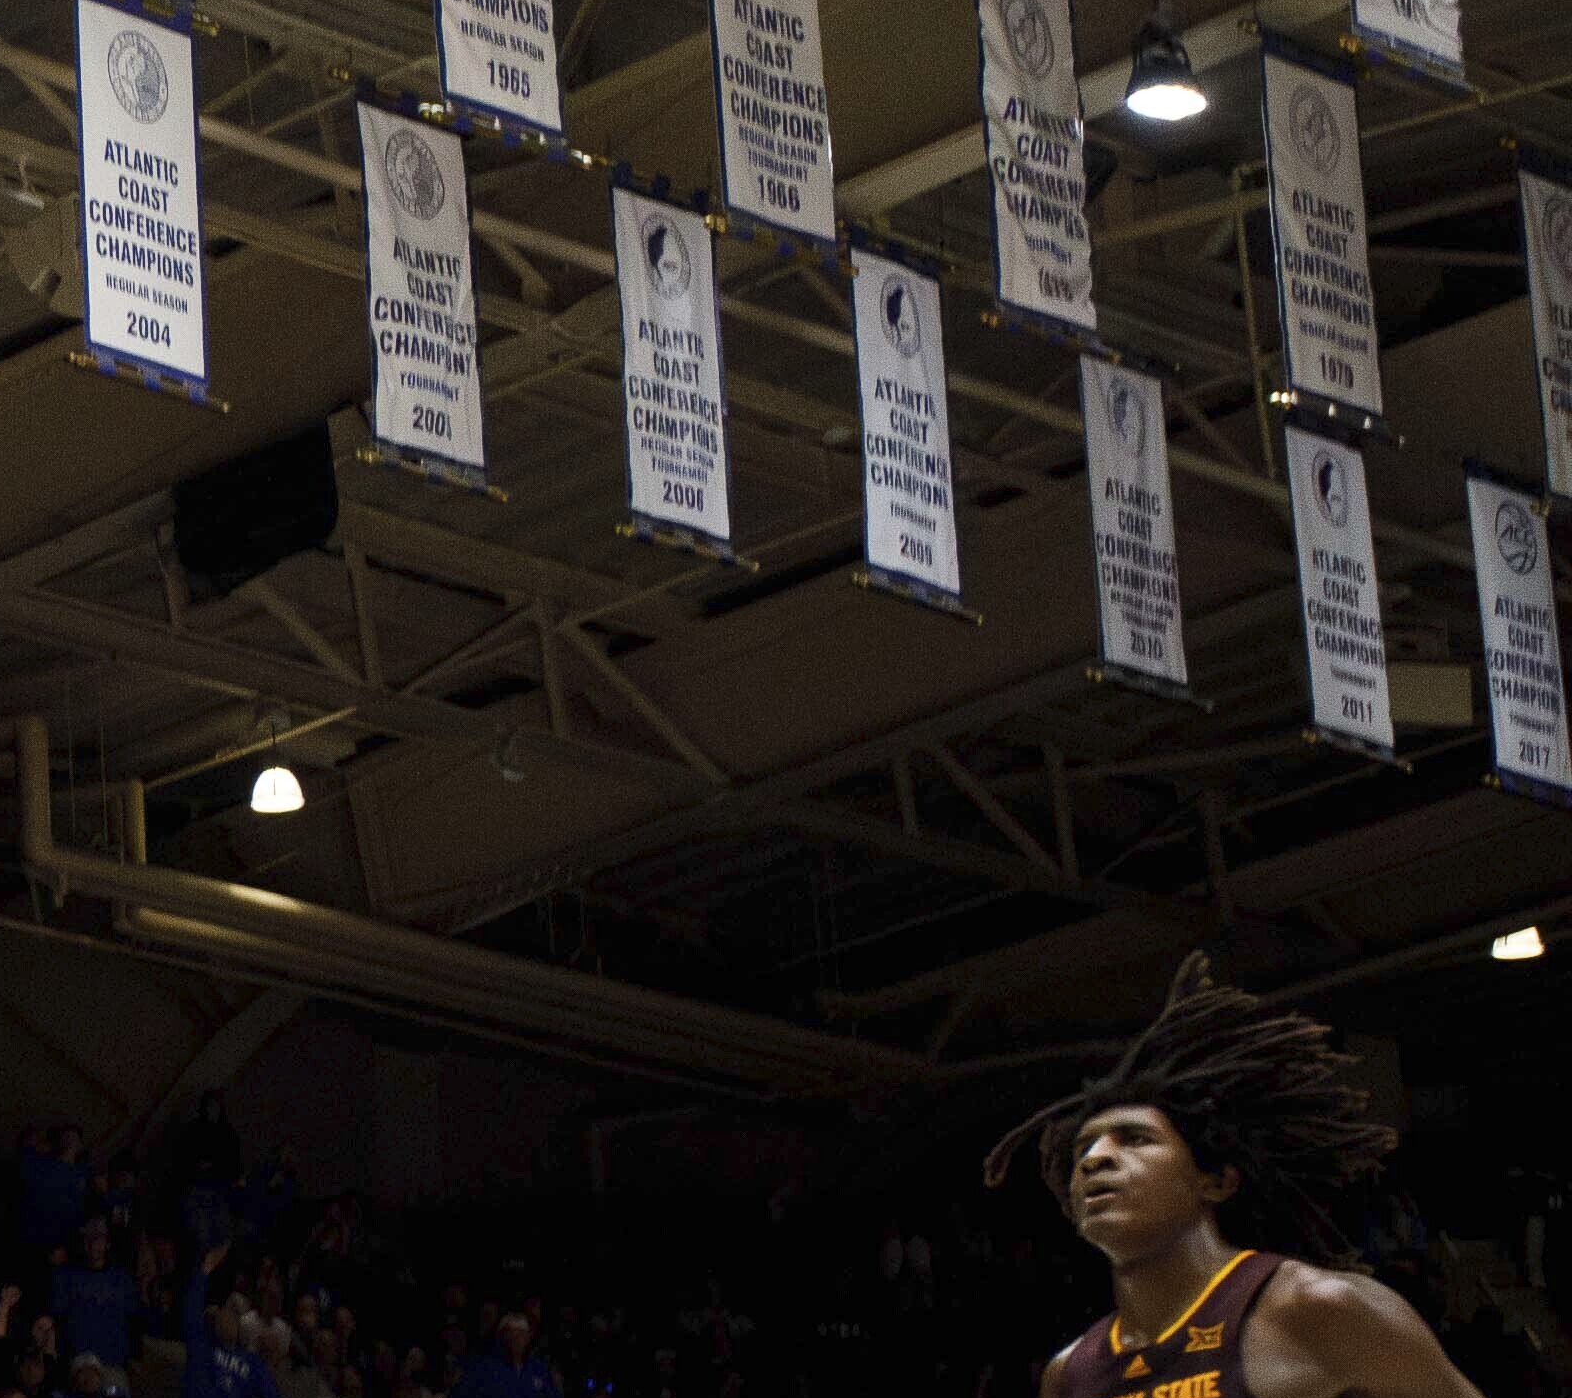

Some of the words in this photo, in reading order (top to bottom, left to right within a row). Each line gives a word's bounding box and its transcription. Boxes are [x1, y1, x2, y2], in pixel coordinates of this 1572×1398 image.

[746, 31, 794, 72] COAST
[722, 54, 826, 115] CONFERENCE
[731, 89, 824, 145] CHAMPIONS
[104, 139, 178, 186] ATLANTIC
[118, 176, 169, 214] COAST
[89, 198, 197, 257] CONFERENCE
[96, 233, 194, 287] CHAMPIONS
[407, 271, 454, 307] COAST
[127, 311, 171, 348] 2004
[653, 350, 699, 387] COAST
[890, 407, 928, 445] COAST
[1341, 694, 1372, 724] 2011
[1519, 738, 1550, 769] 2017
